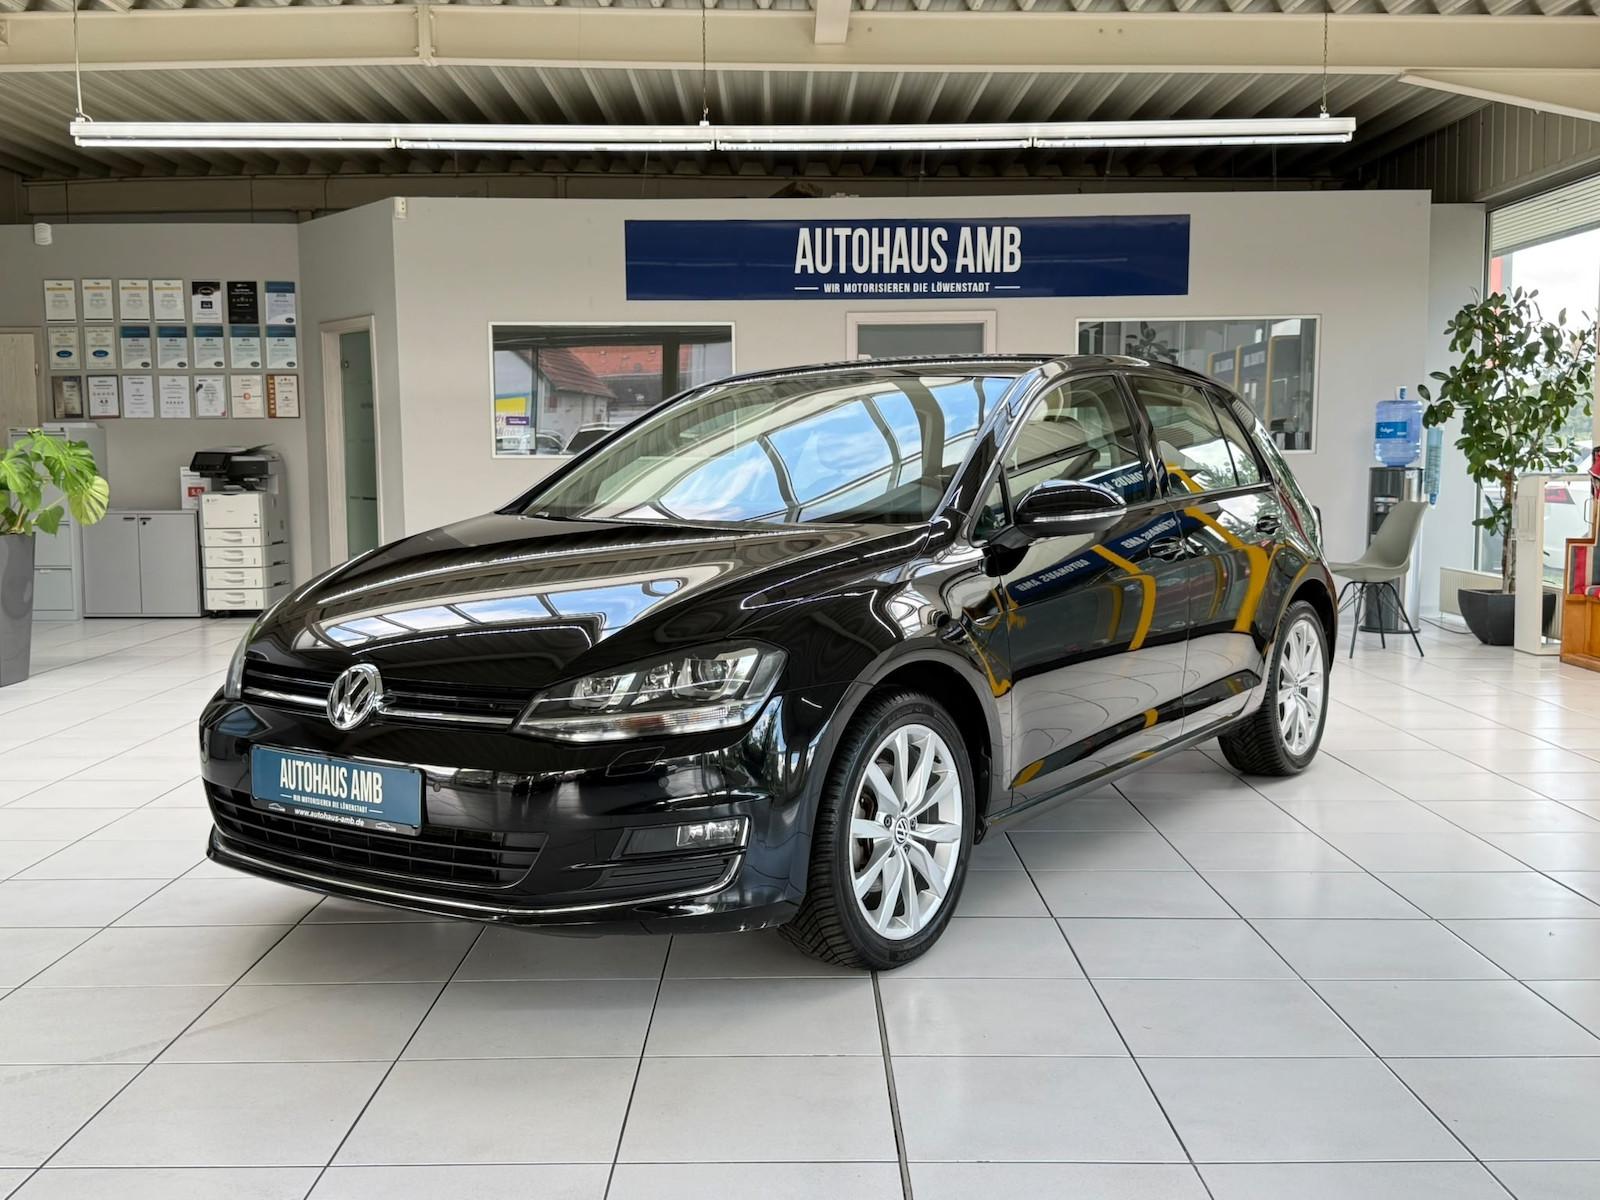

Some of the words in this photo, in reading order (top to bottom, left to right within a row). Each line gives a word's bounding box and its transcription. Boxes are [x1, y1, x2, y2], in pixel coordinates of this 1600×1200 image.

[794, 227, 949, 274] AUTOHAUS
[955, 226, 1022, 273] AMB
[824, 283, 841, 293] WIR
[844, 282, 911, 293] MOTORISIEREN
[913, 283, 928, 293] DIE
[931, 281, 990, 293] LÖWENSTADT
[280, 758, 348, 799] AUTOHAUS
[351, 769, 383, 804] AMB
[294, 808, 365, 827] www.autohaus-amb.de
